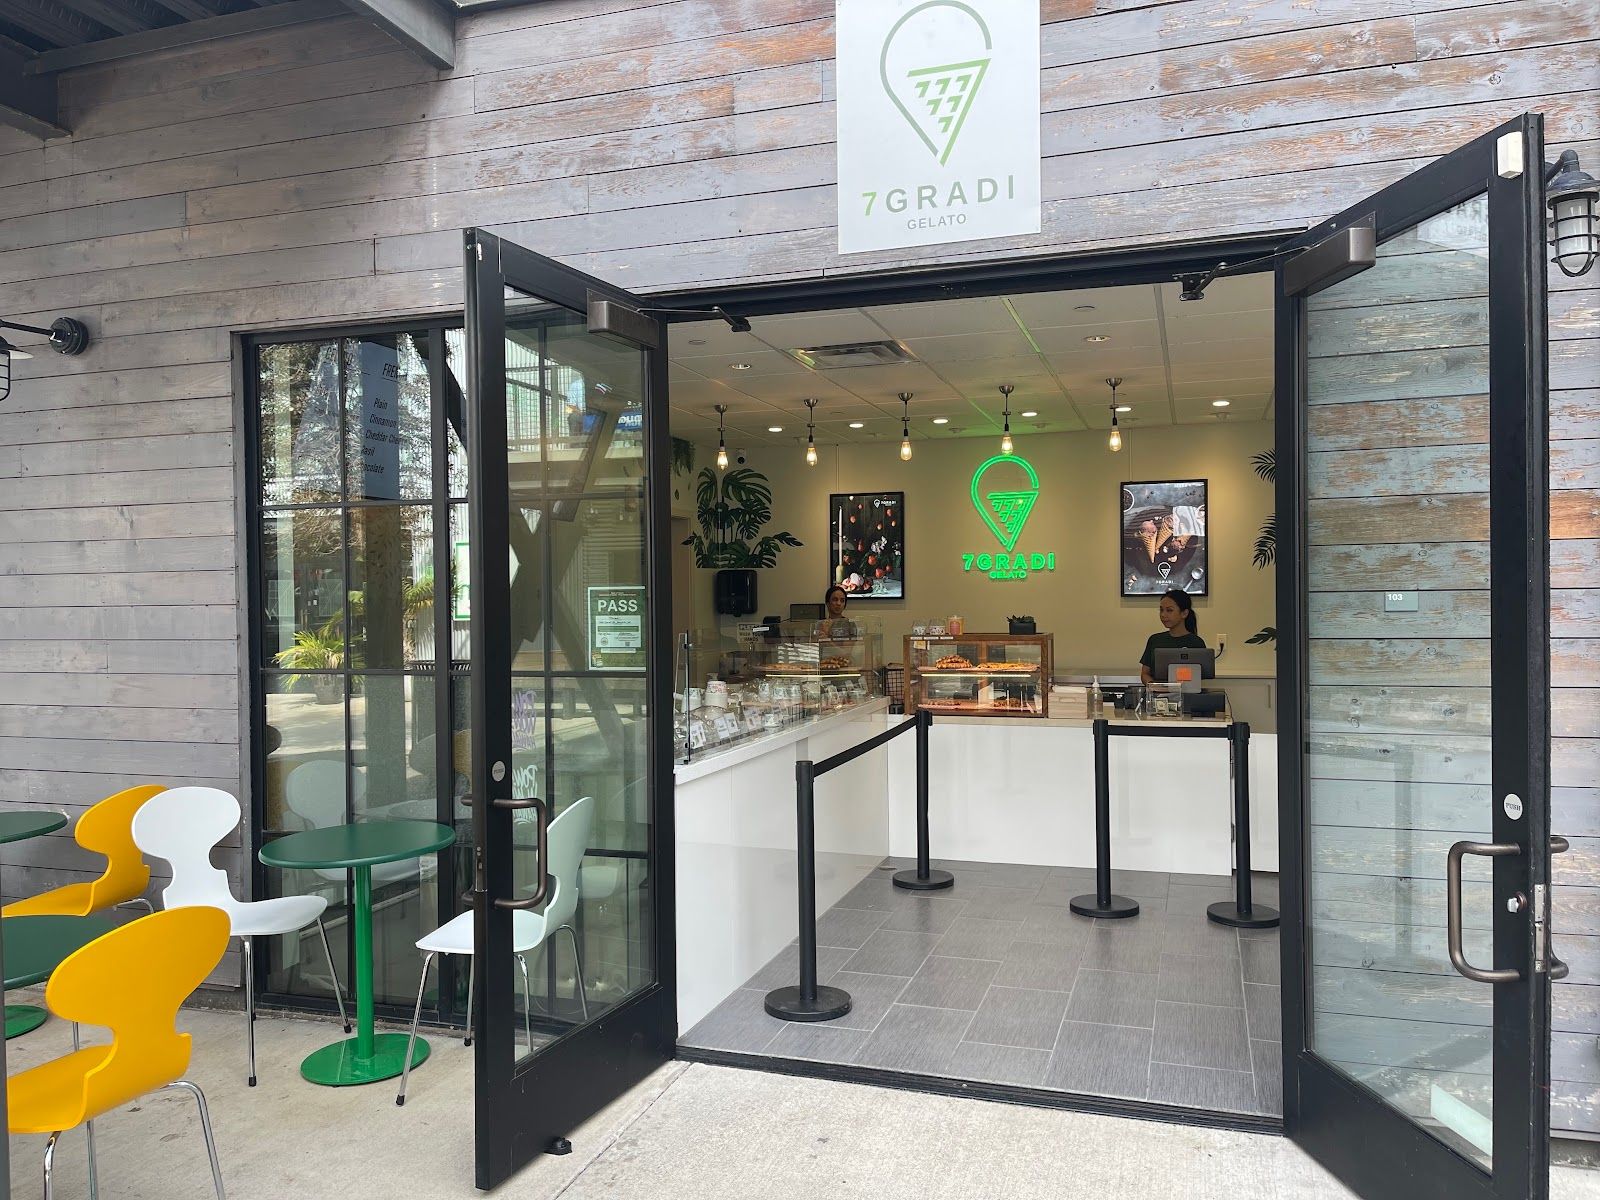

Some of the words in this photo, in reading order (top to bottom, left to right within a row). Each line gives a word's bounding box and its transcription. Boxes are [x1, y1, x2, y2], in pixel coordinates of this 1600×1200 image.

[907, 213, 967, 230] GELATO
[373, 398, 388, 410] Plain
[365, 430, 388, 442] Cheddar
[962, 552, 1055, 571] 7GRADI
[989, 571, 1027, 579] GELATO
[1387, 593, 1403, 601] 103
[597, 599, 638, 612] PASS
